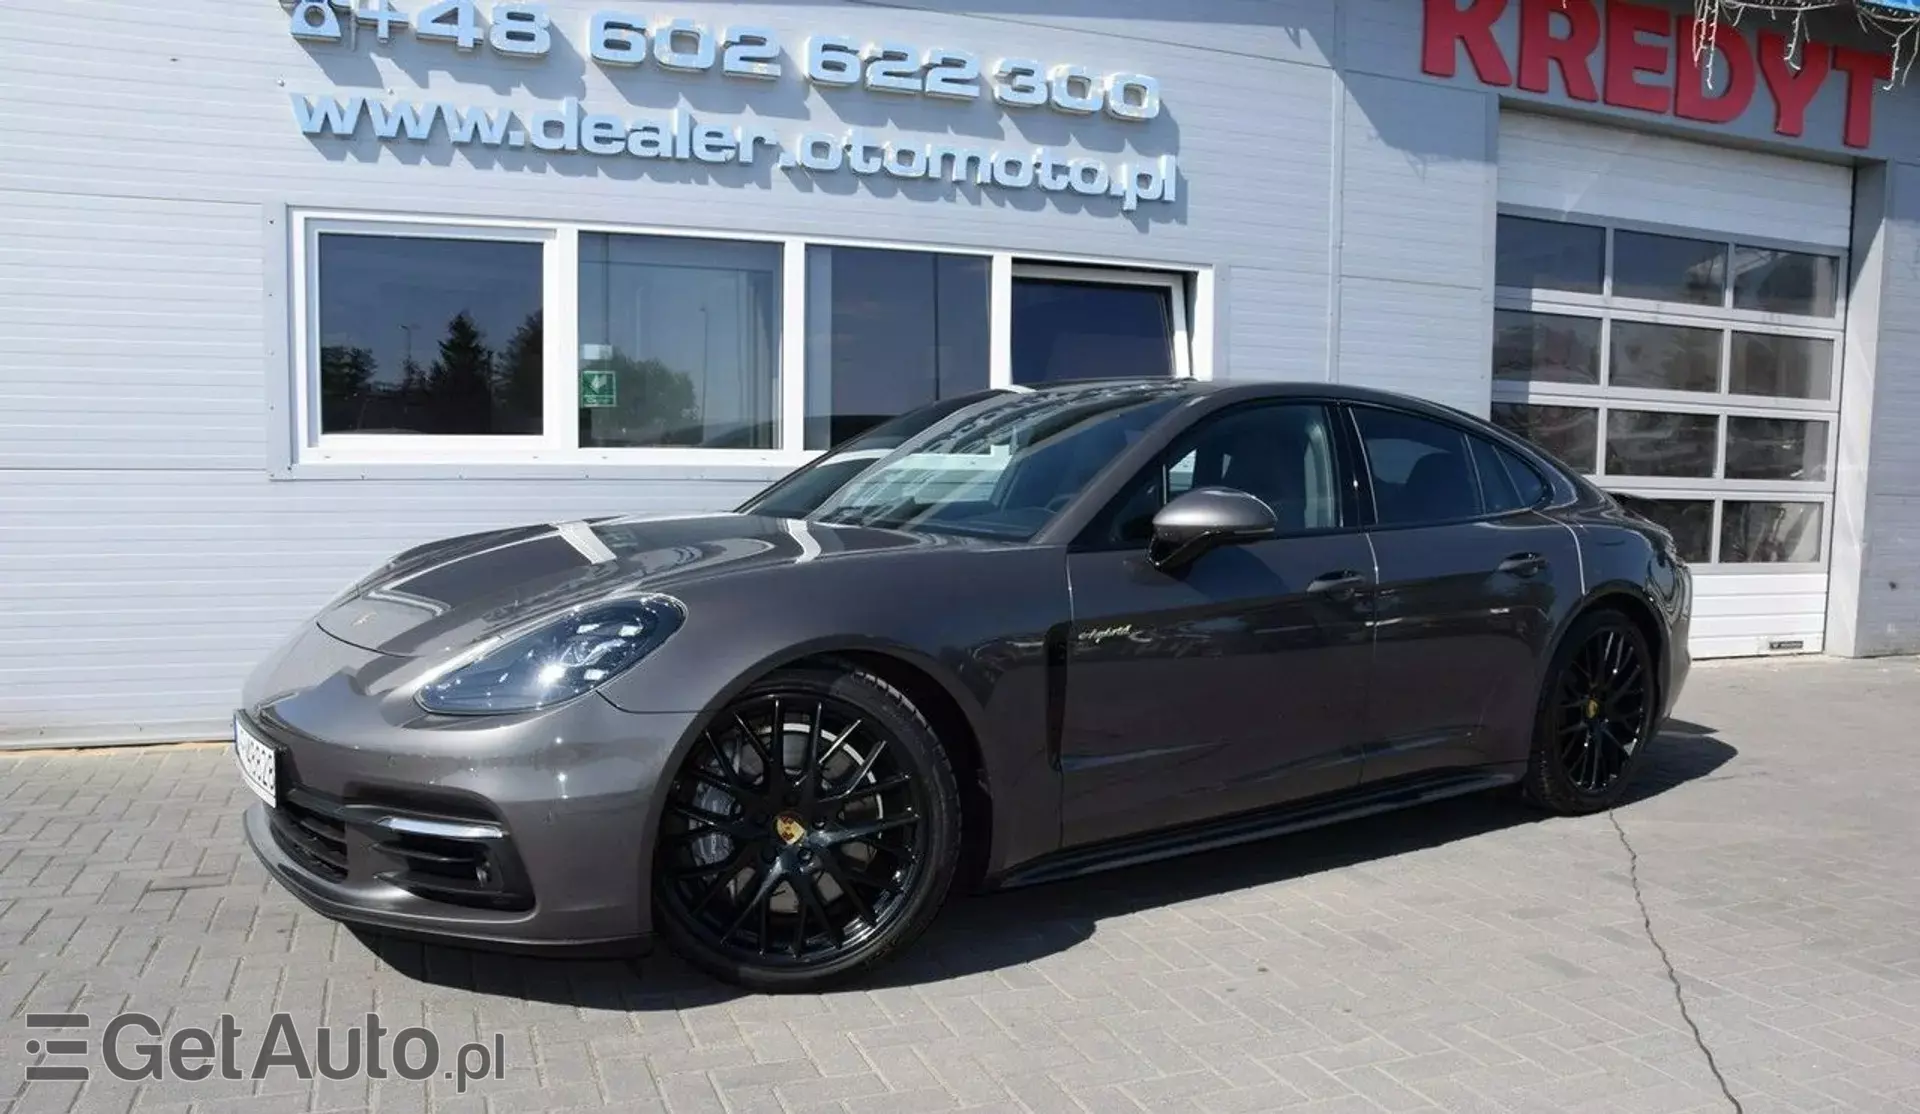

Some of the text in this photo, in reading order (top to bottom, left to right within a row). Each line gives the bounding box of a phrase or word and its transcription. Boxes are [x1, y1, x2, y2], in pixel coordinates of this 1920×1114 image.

[354, 0, 1161, 121] +48 602 622 300
[1421, 0, 1893, 149] KREDYT
[291, 92, 1178, 212] www.dealer.otomoto.pl
